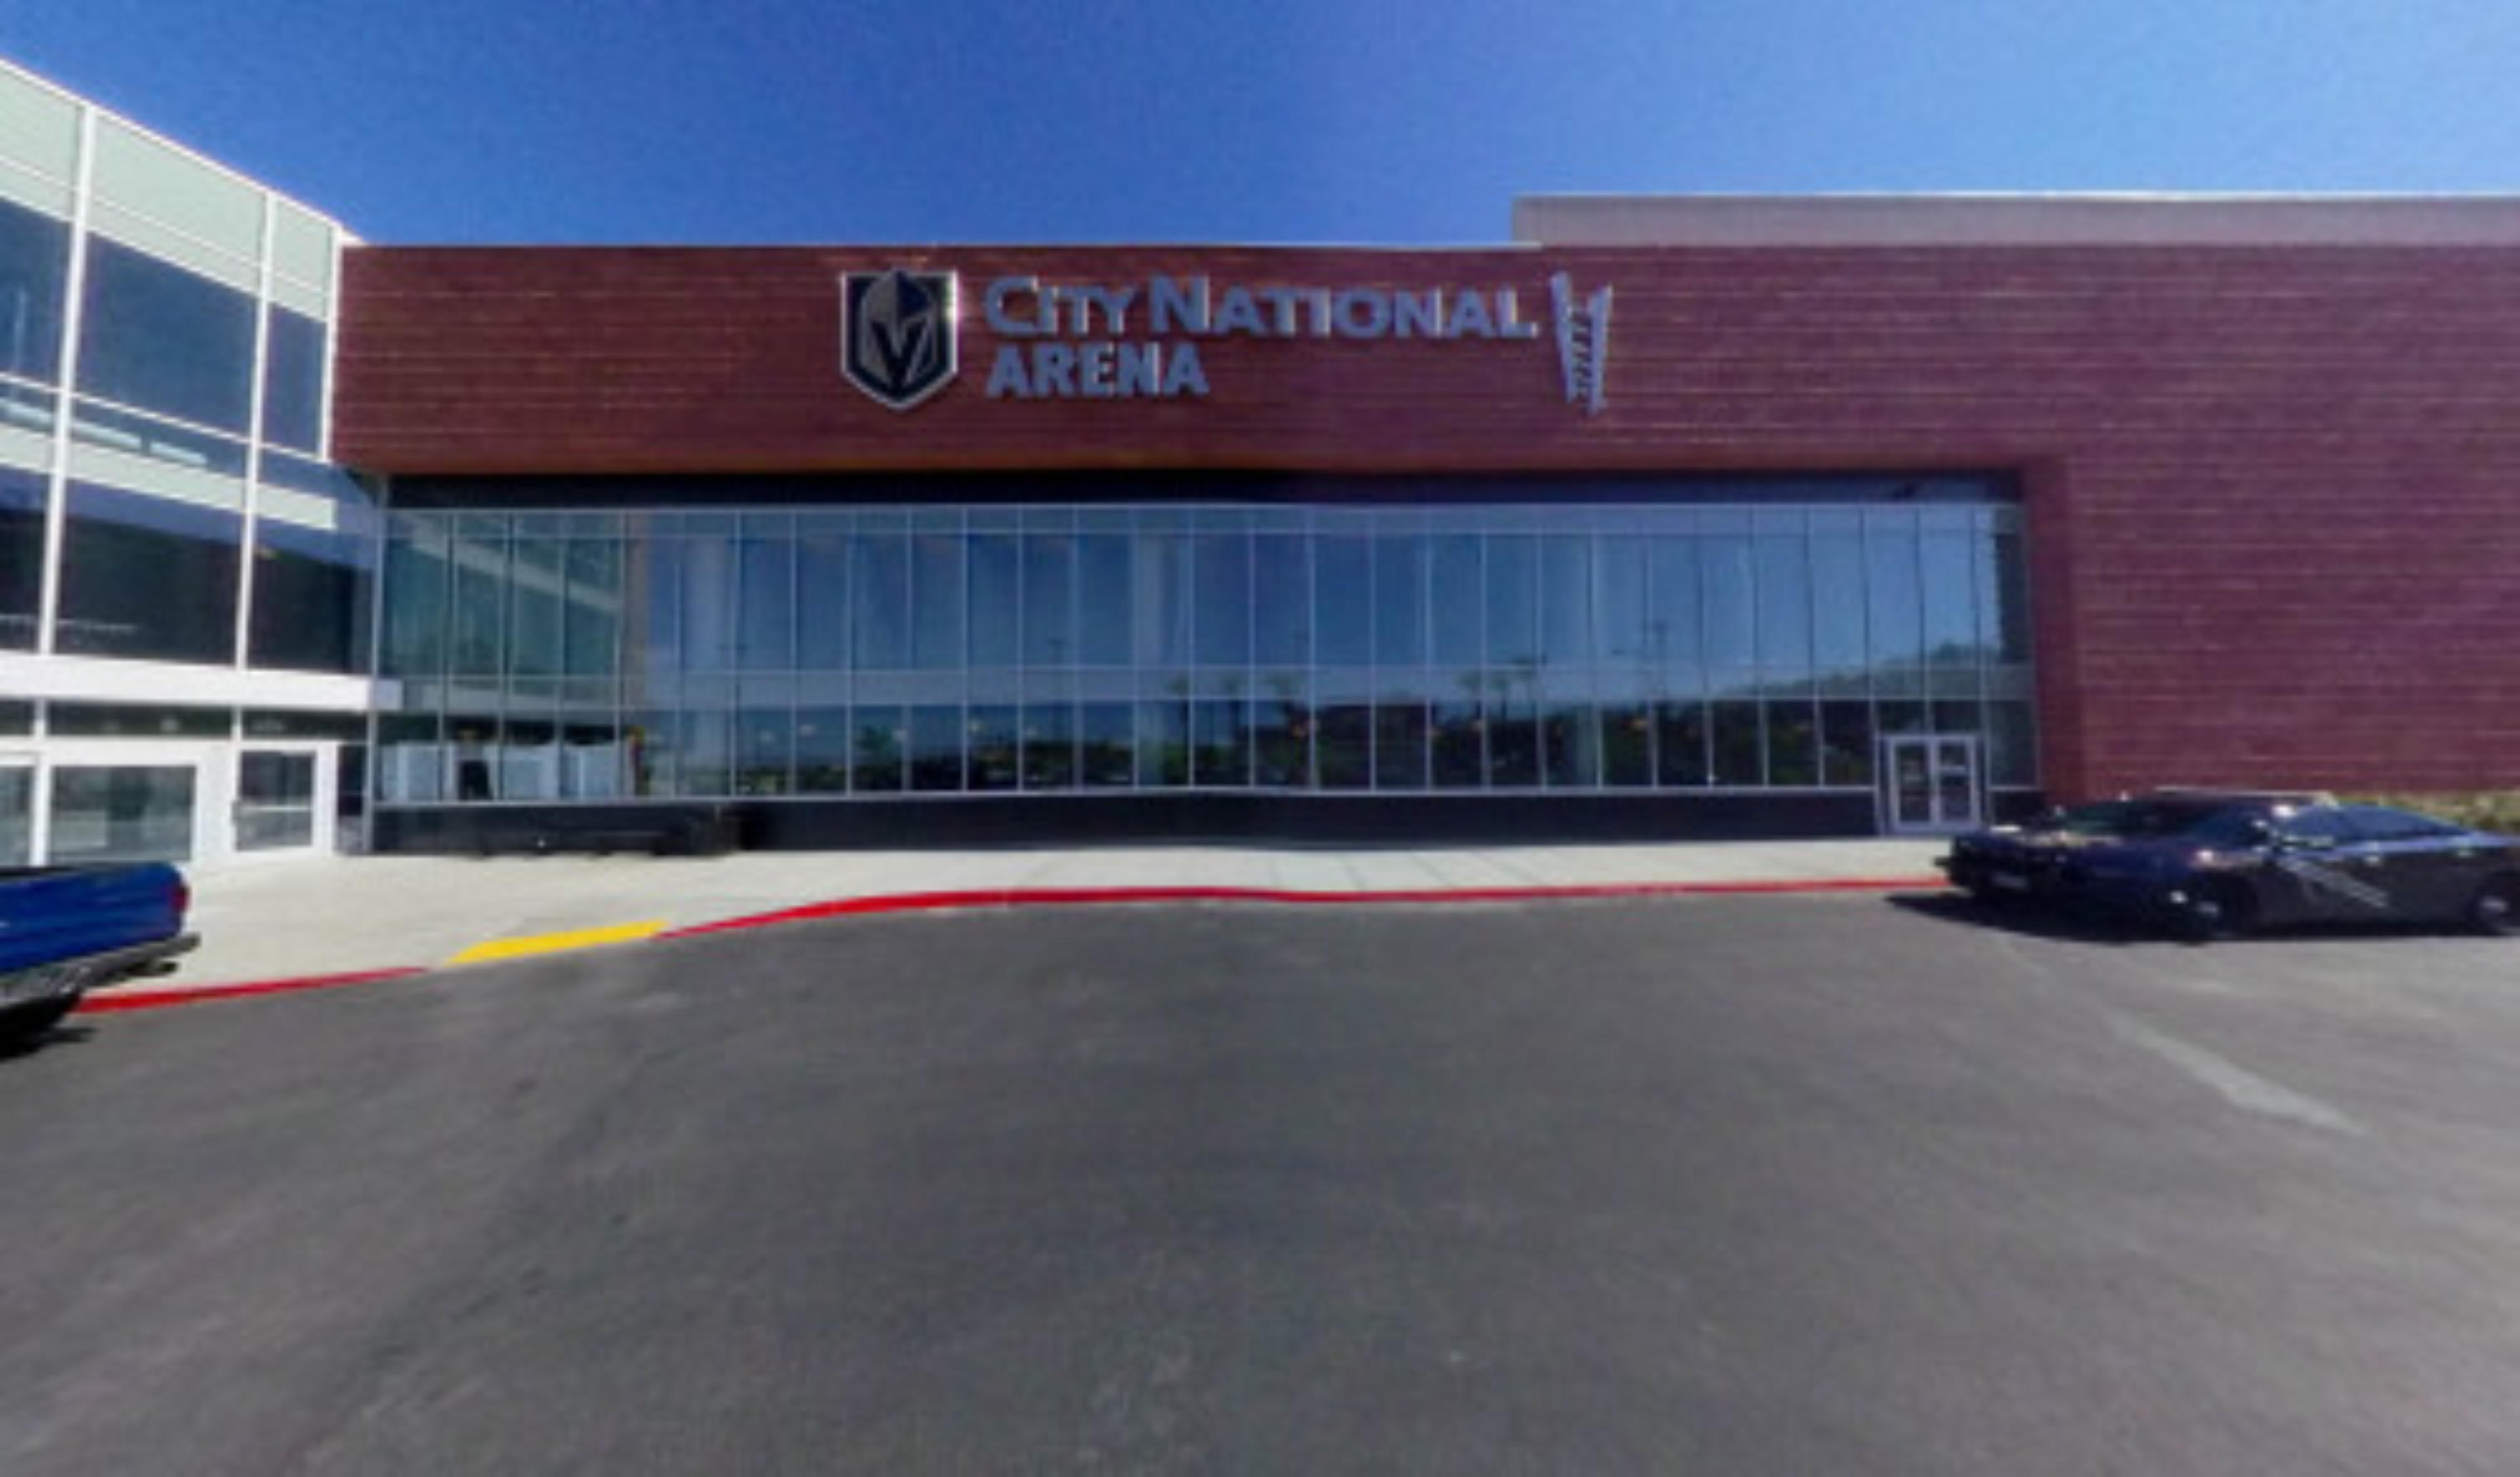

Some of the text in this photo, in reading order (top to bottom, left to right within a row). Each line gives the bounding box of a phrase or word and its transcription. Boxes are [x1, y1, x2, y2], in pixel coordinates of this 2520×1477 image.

[986, 274, 1540, 337] CITY NATIONAL
[986, 341, 1210, 398] ARENA
